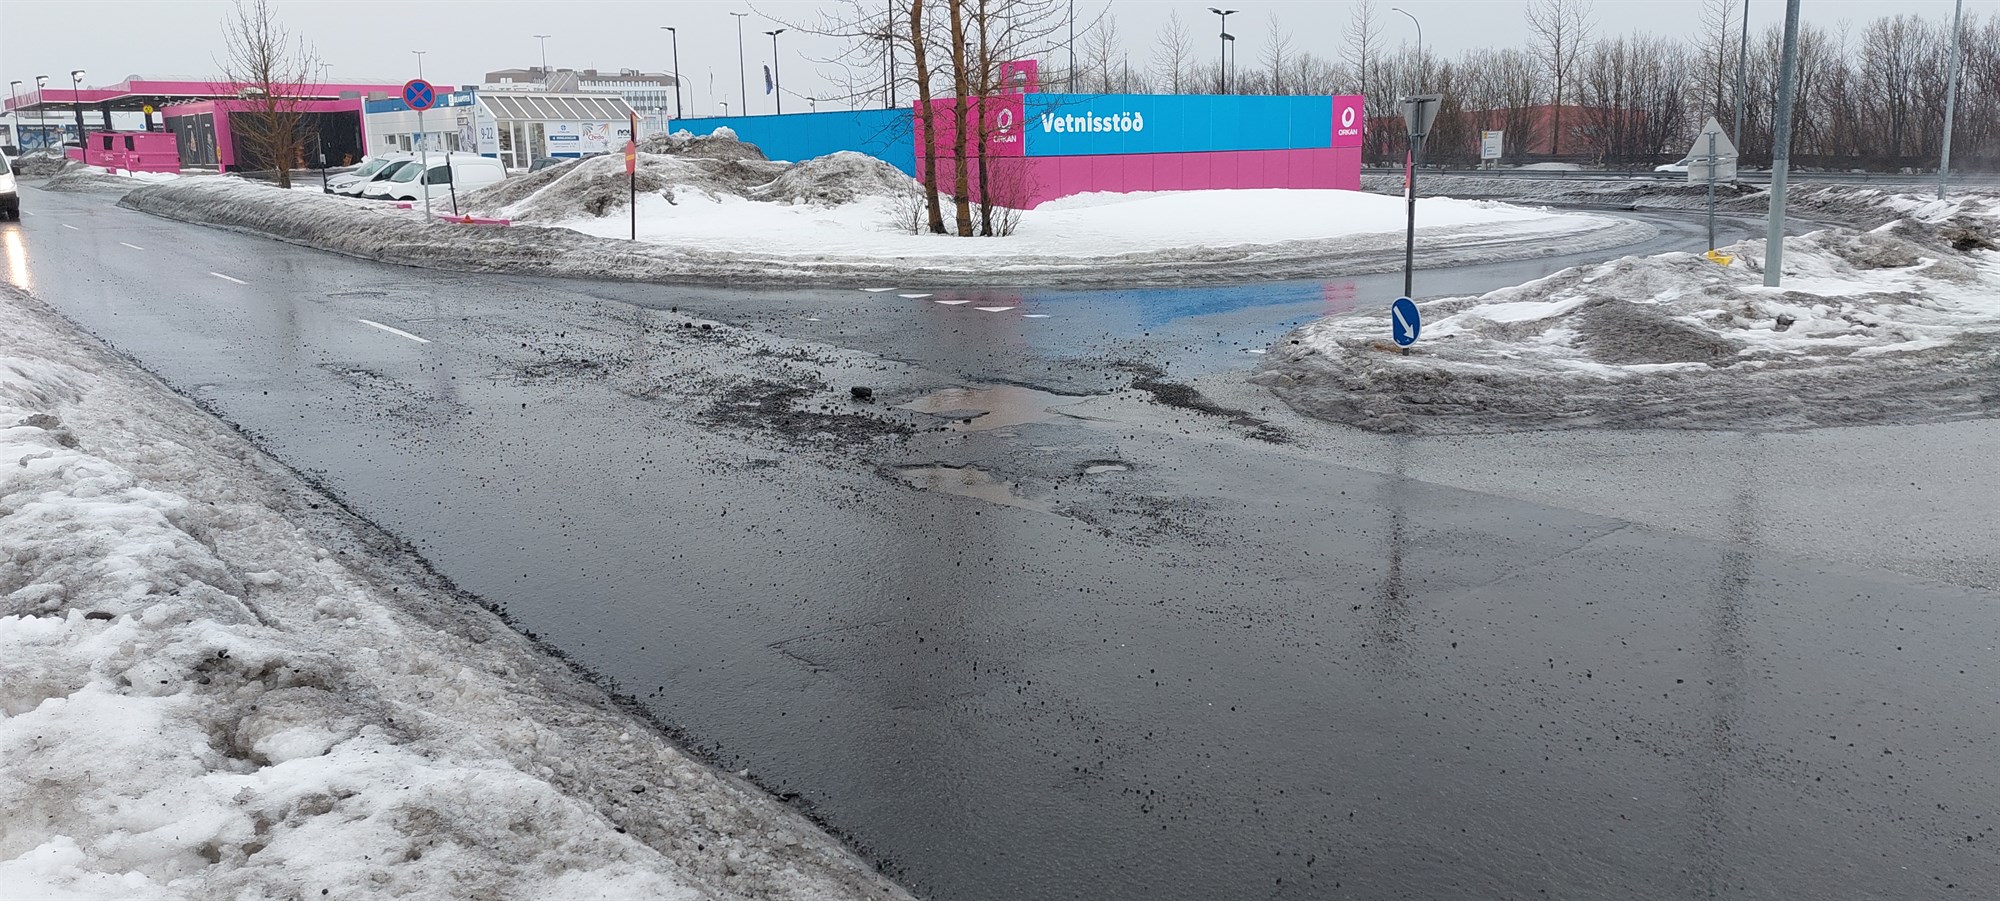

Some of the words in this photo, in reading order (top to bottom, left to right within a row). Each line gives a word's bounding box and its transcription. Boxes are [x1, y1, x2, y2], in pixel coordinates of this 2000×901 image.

[1041, 111, 1144, 132] Vetnisstöð
[481, 128, 494, 139] 9-22
[1338, 128, 1358, 136] ORKAN
